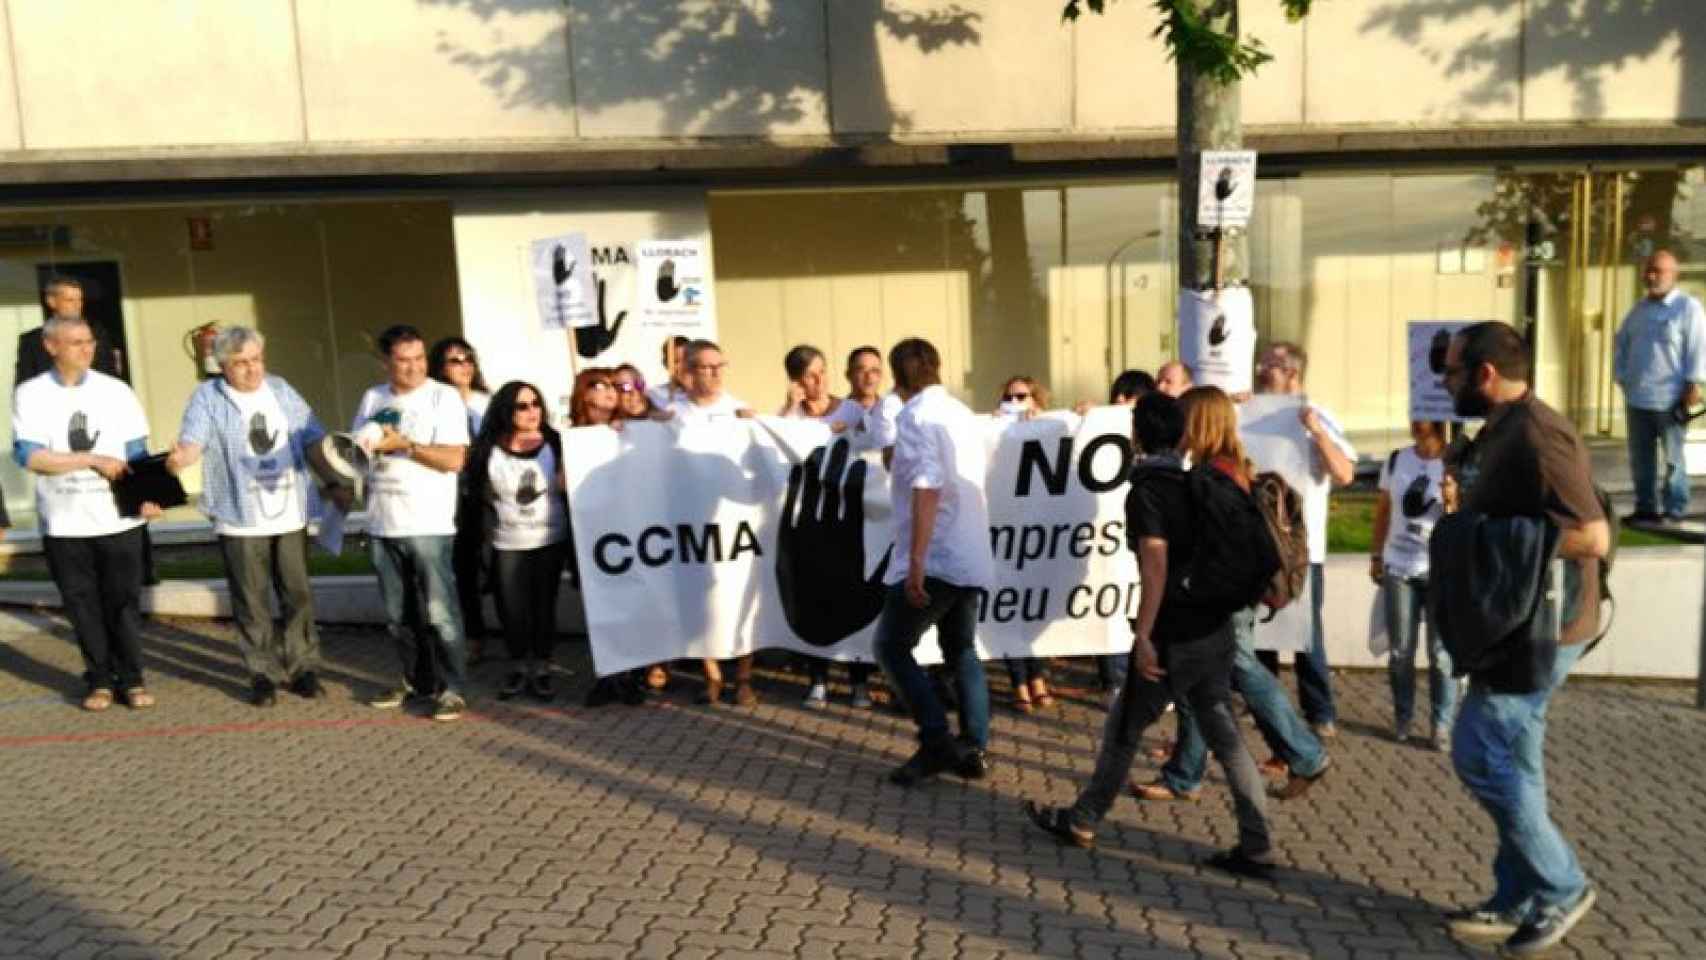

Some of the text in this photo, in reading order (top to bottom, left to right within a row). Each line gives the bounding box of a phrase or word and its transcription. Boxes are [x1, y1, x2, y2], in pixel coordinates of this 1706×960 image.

[591, 246, 629, 265] MA
[1015, 433, 1134, 494] NO
[593, 521, 763, 575] CCMA
